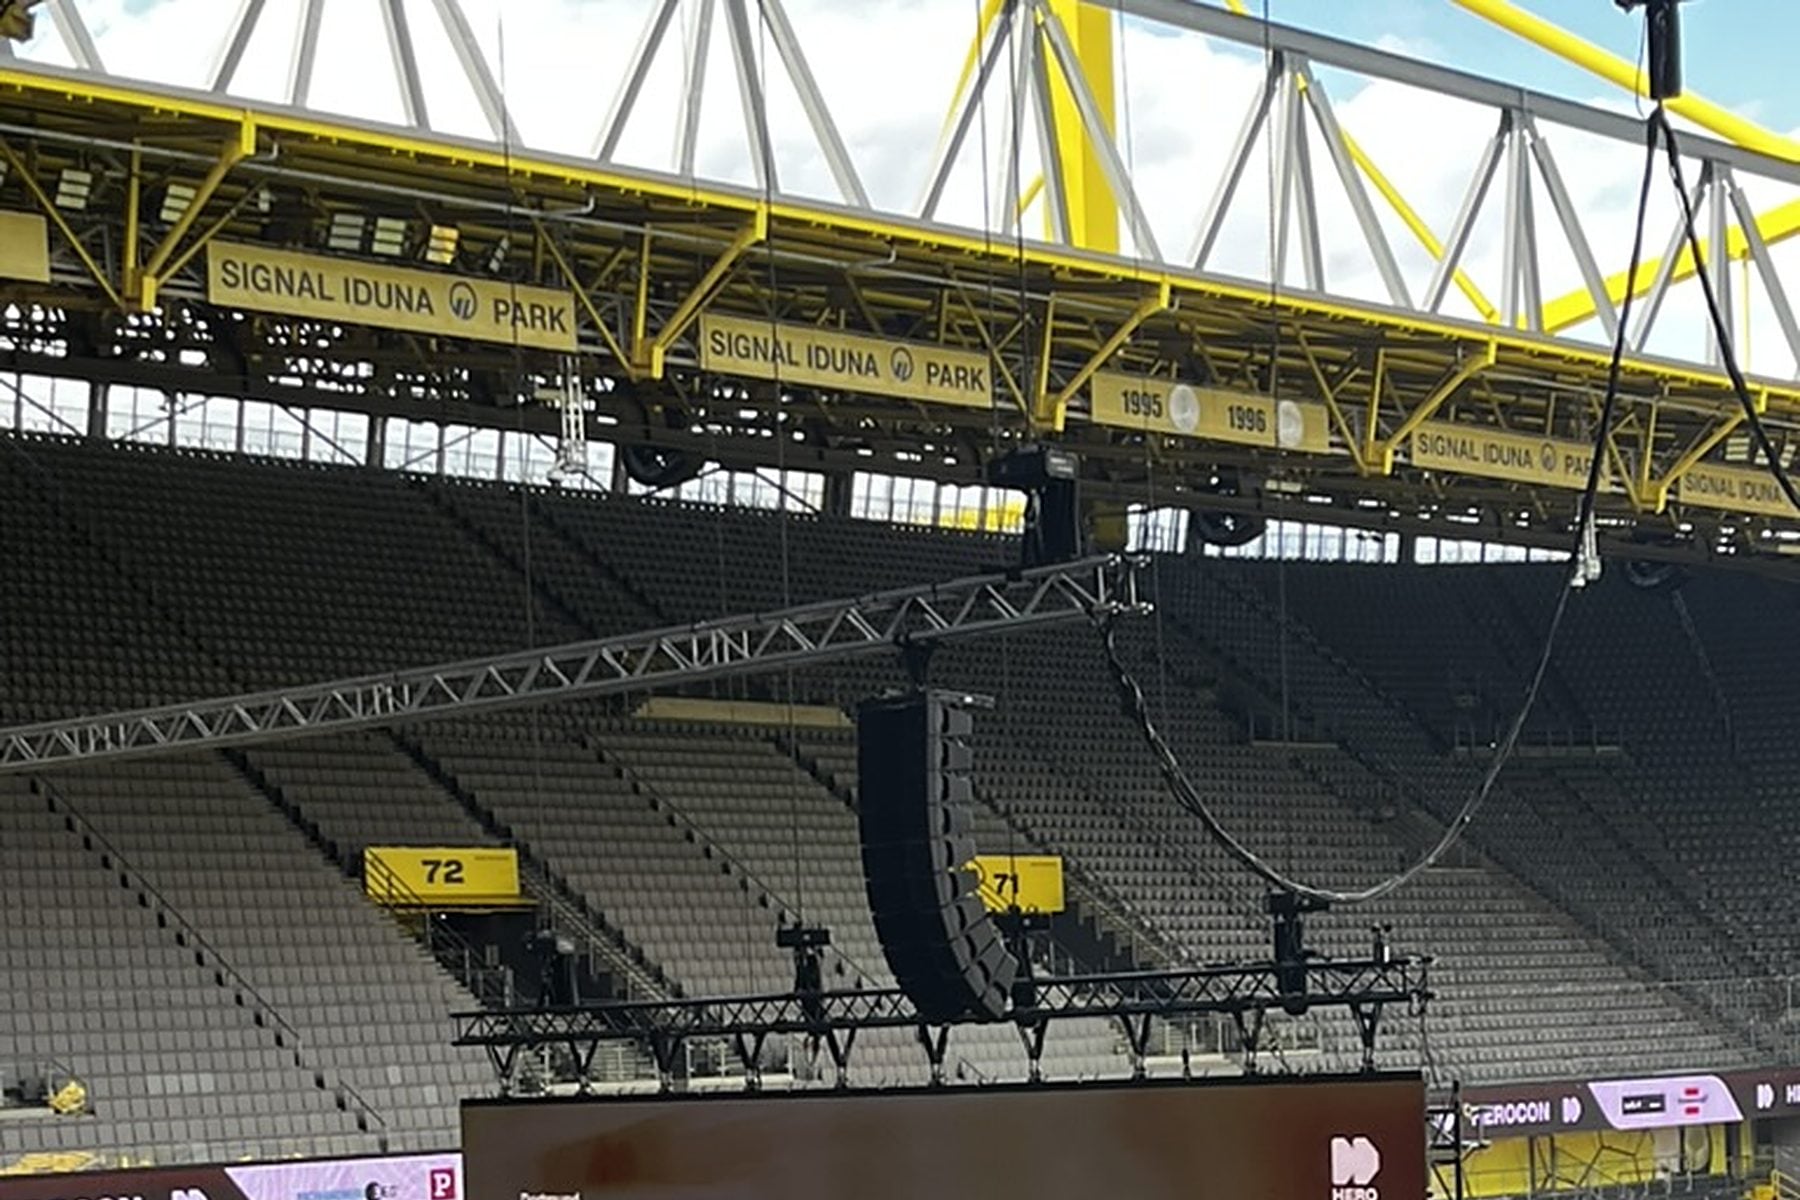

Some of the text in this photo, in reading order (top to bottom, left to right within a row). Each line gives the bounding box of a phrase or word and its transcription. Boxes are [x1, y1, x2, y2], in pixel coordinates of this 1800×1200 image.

[221, 259, 568, 333] SIGNAL IDUNA PARK
[709, 329, 986, 392] SIGNAL IDUNA PARK
[1121, 389, 1164, 418] 1995
[1226, 405, 1267, 432] 1996
[1418, 432, 1480, 462] SIGNAL
[1483, 443, 1534, 469] IDUNA
[421, 859, 465, 884] 72
[993, 873, 1019, 894] 71
